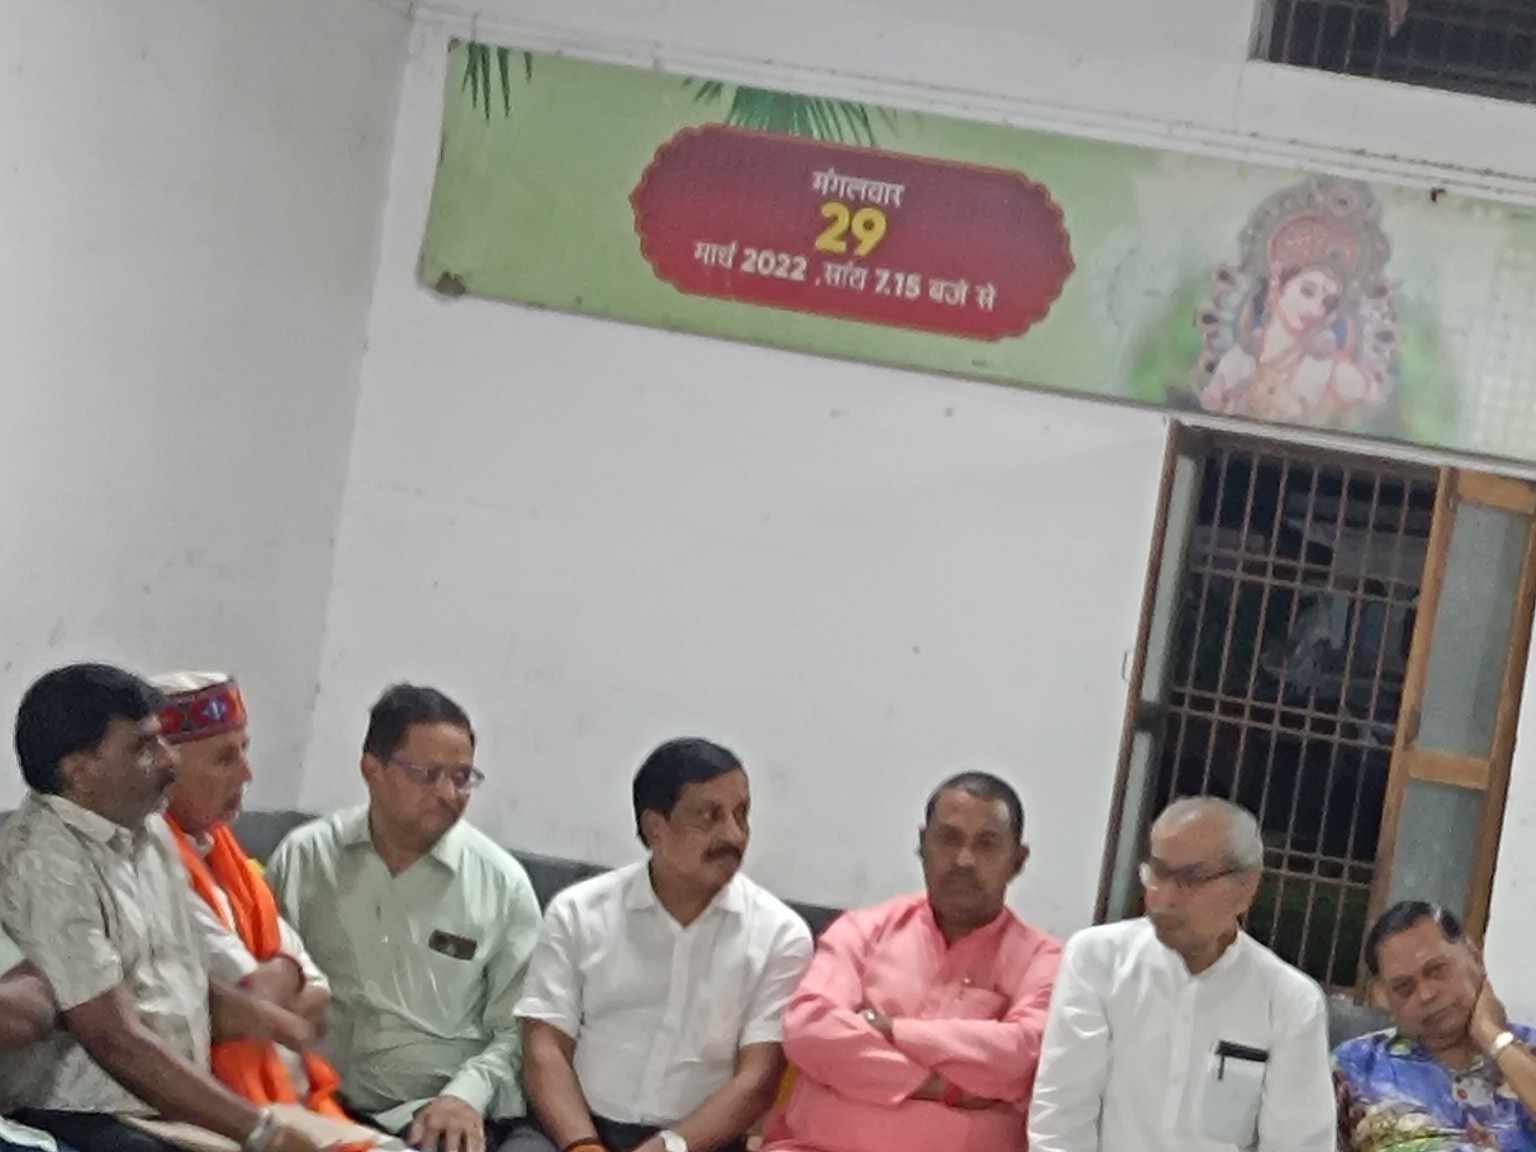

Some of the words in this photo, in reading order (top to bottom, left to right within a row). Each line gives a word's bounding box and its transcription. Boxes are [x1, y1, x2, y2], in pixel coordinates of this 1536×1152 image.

[812, 168, 905, 207] मंगलवार
[814, 202, 888, 256] 29
[740, 249, 807, 281] 2022
[929, 278, 968, 306] बजे
[975, 283, 997, 311] से
